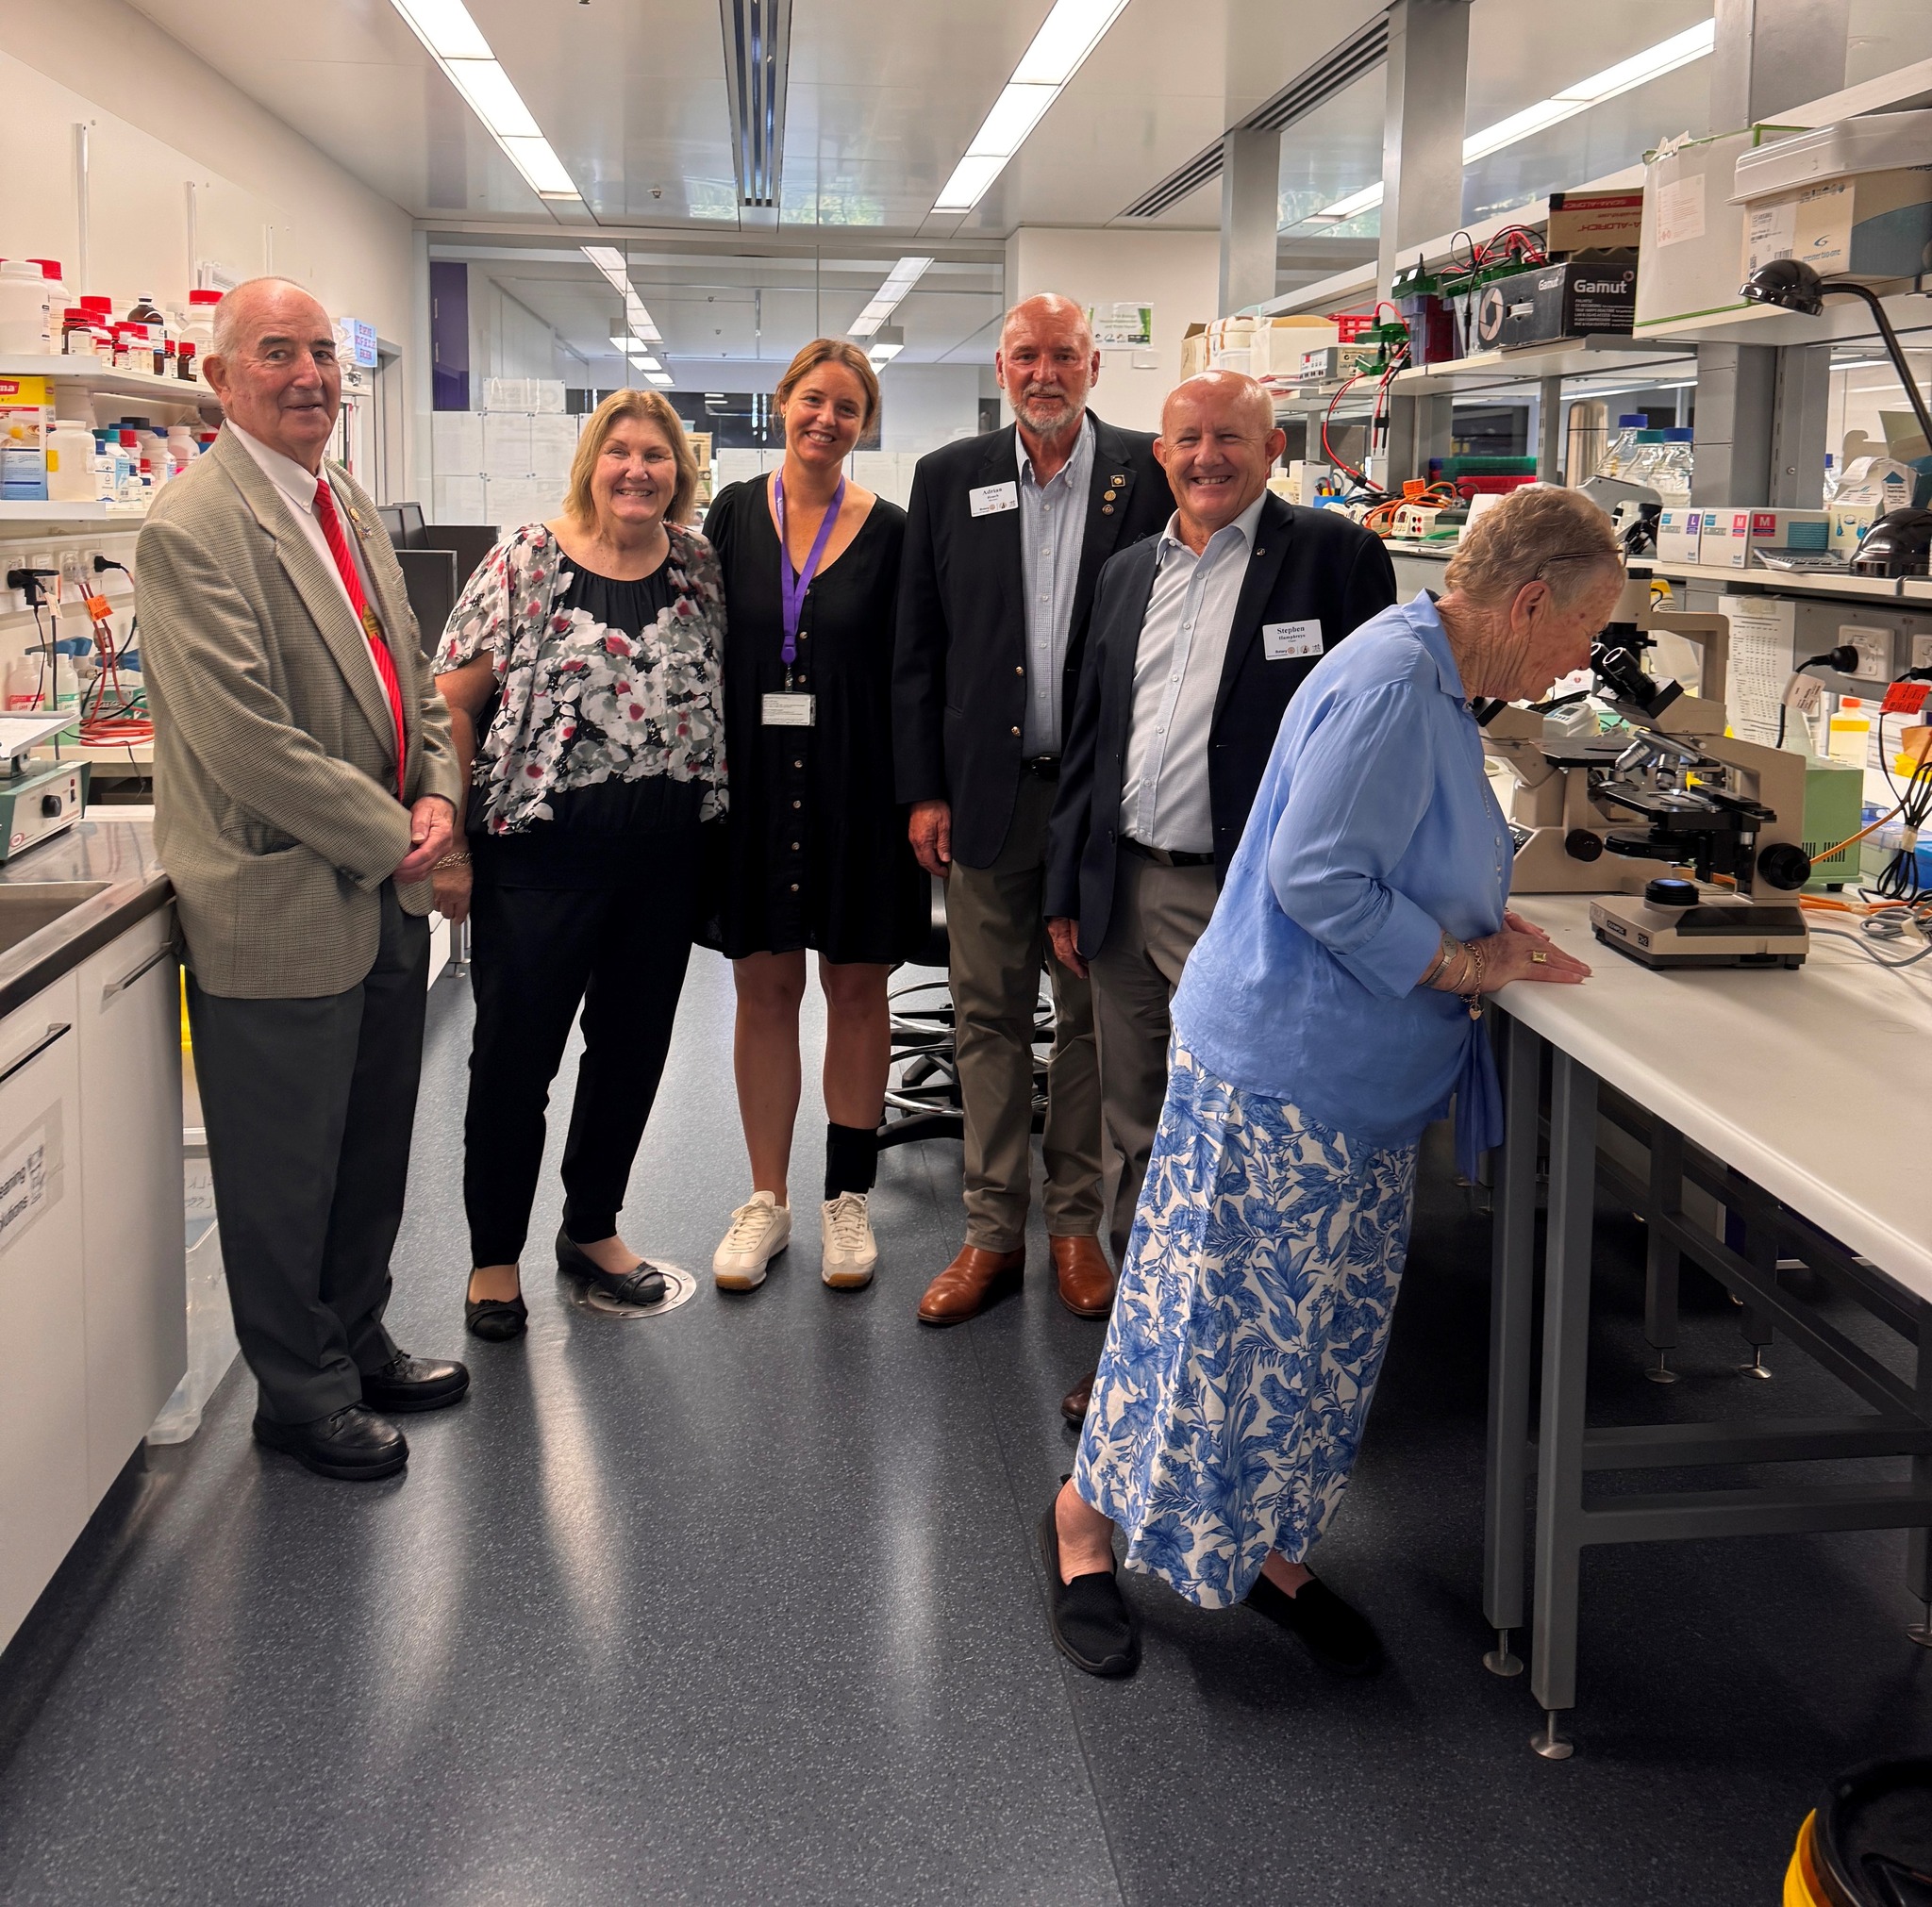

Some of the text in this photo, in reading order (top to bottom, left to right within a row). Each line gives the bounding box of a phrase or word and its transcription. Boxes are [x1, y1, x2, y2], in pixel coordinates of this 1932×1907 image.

[1579, 222, 1641, 232] A-ALDRICH
[1538, 277, 1559, 291] Gamut
[1574, 279, 1627, 294] Gamut
[1690, 515, 1697, 525] L
[1737, 517, 1744, 526] M
[1759, 516, 1771, 526] M
[1276, 626, 1306, 635] Stephen
